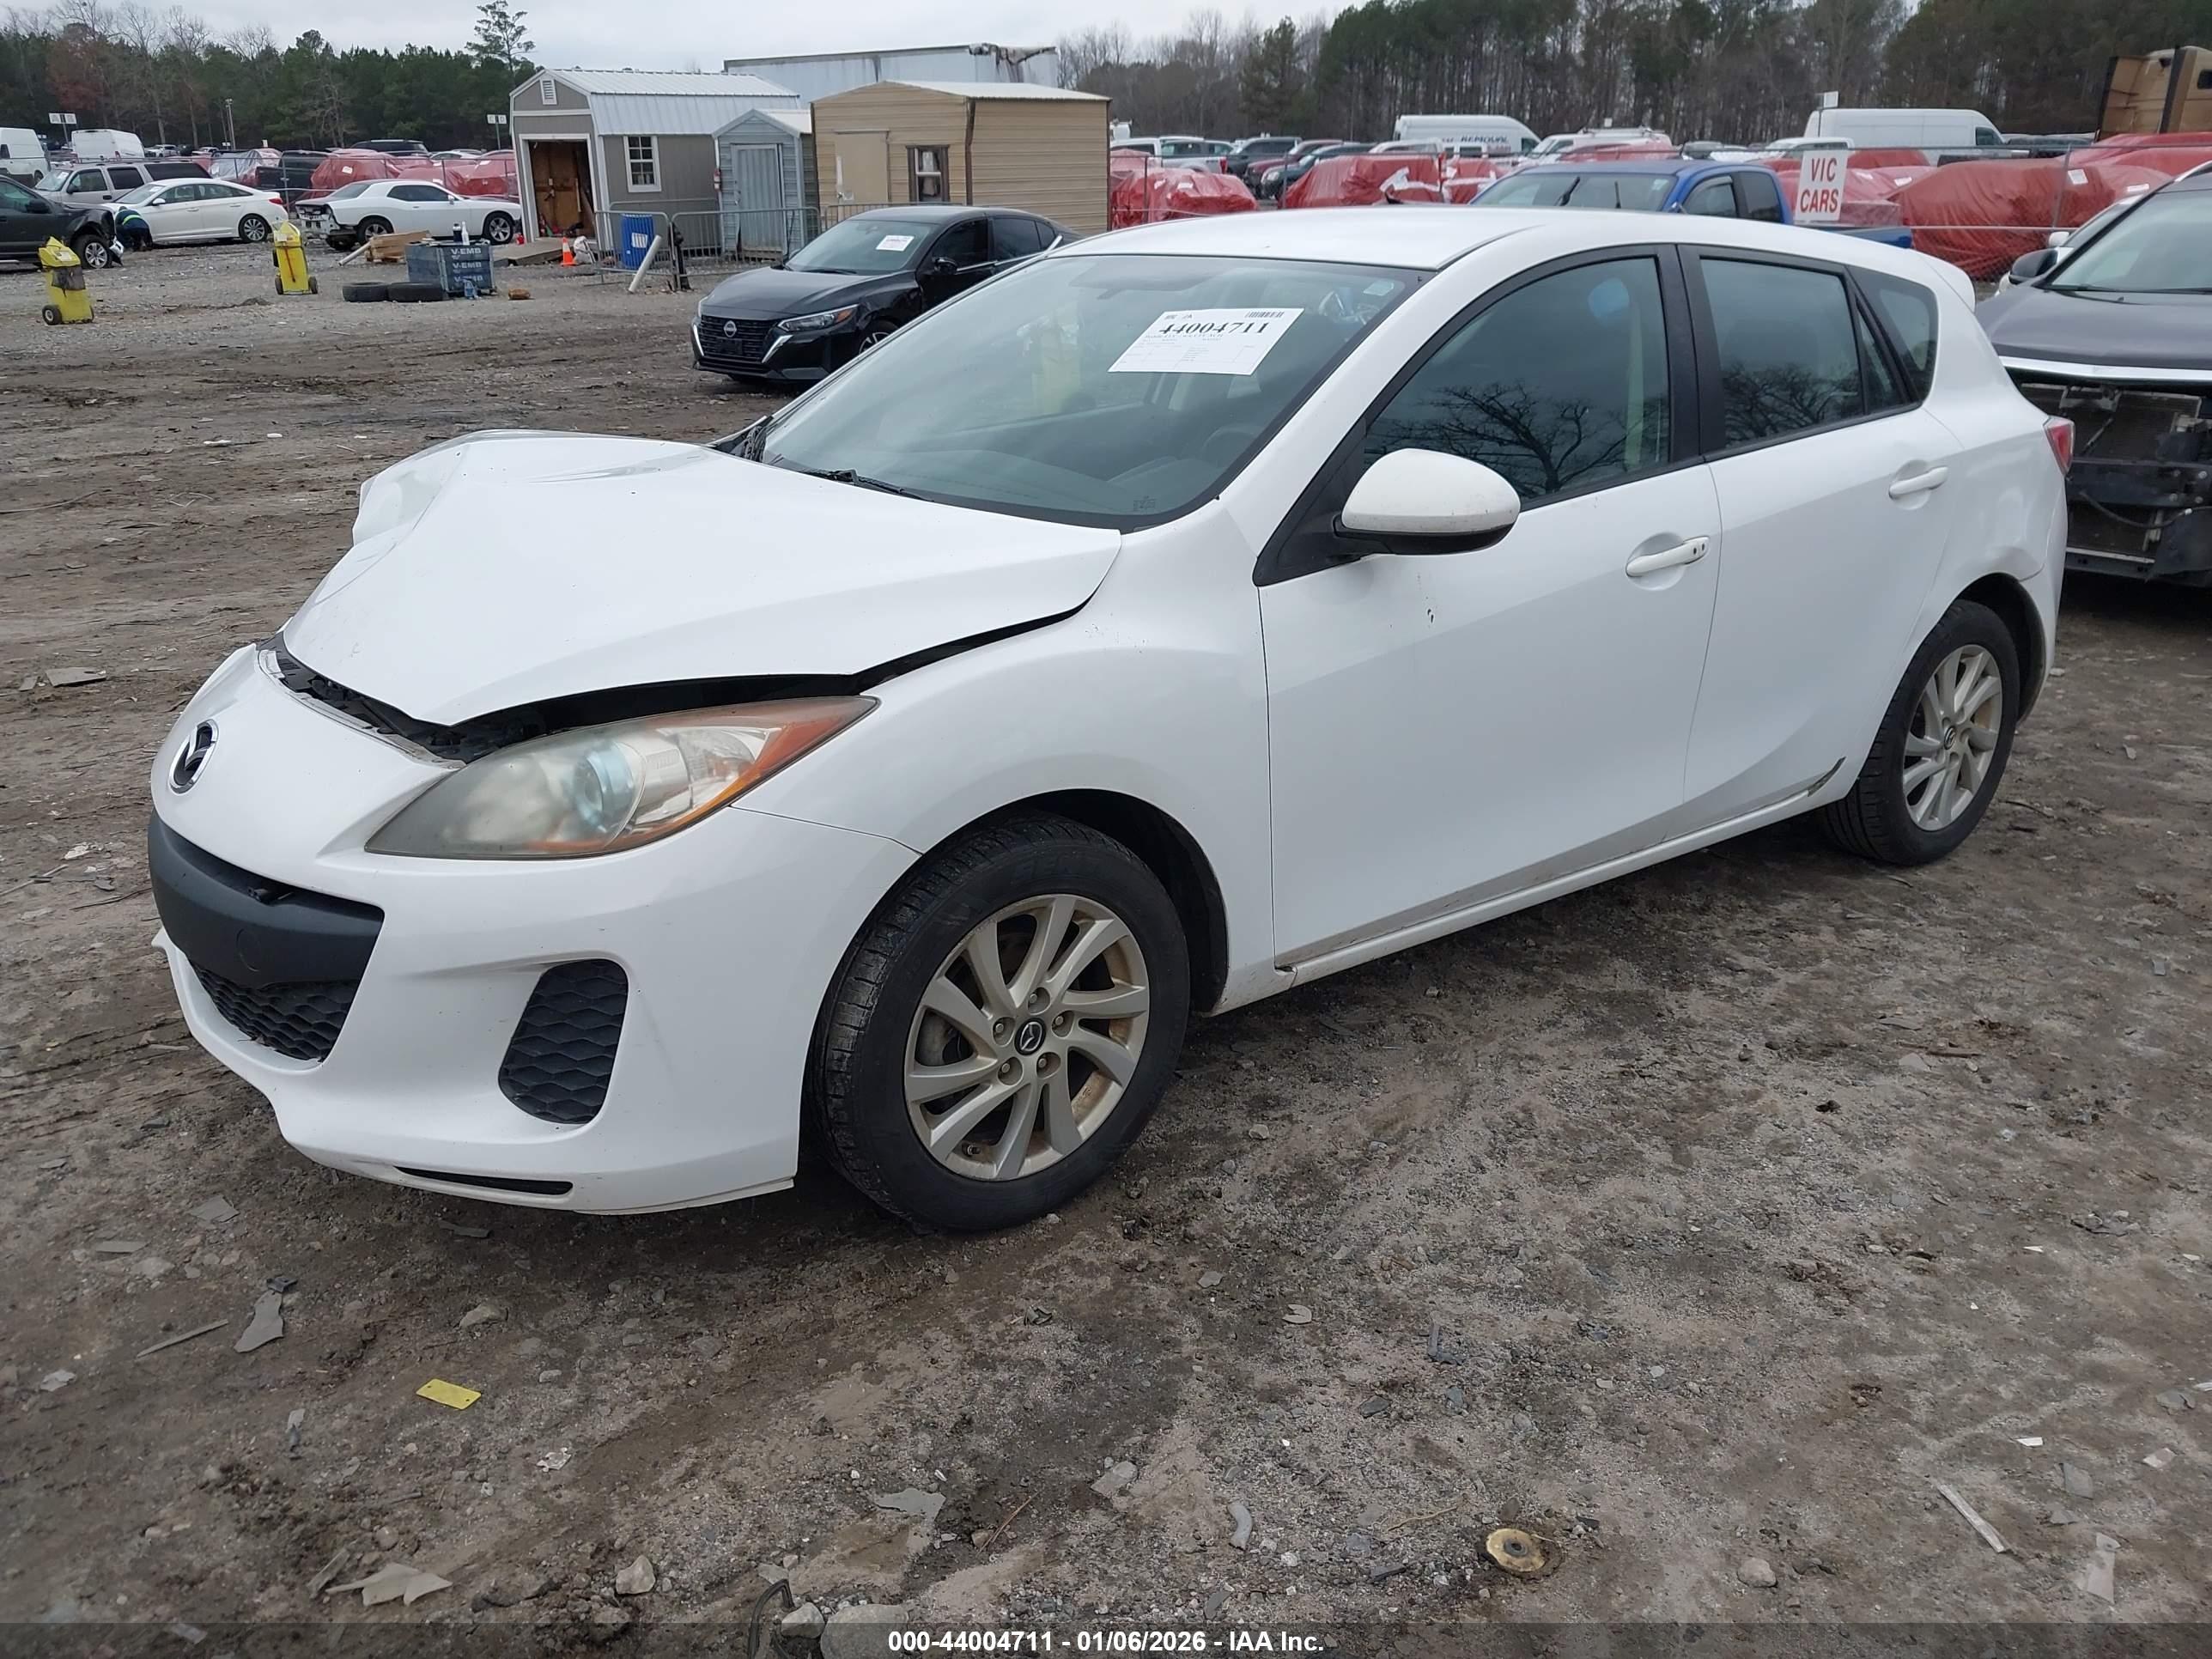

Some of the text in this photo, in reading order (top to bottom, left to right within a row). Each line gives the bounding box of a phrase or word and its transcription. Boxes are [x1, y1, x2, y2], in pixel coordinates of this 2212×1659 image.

[1812, 157, 1837, 182] VIC
[1800, 188, 1839, 214] CARS
[1159, 322, 1269, 334] 44004711
